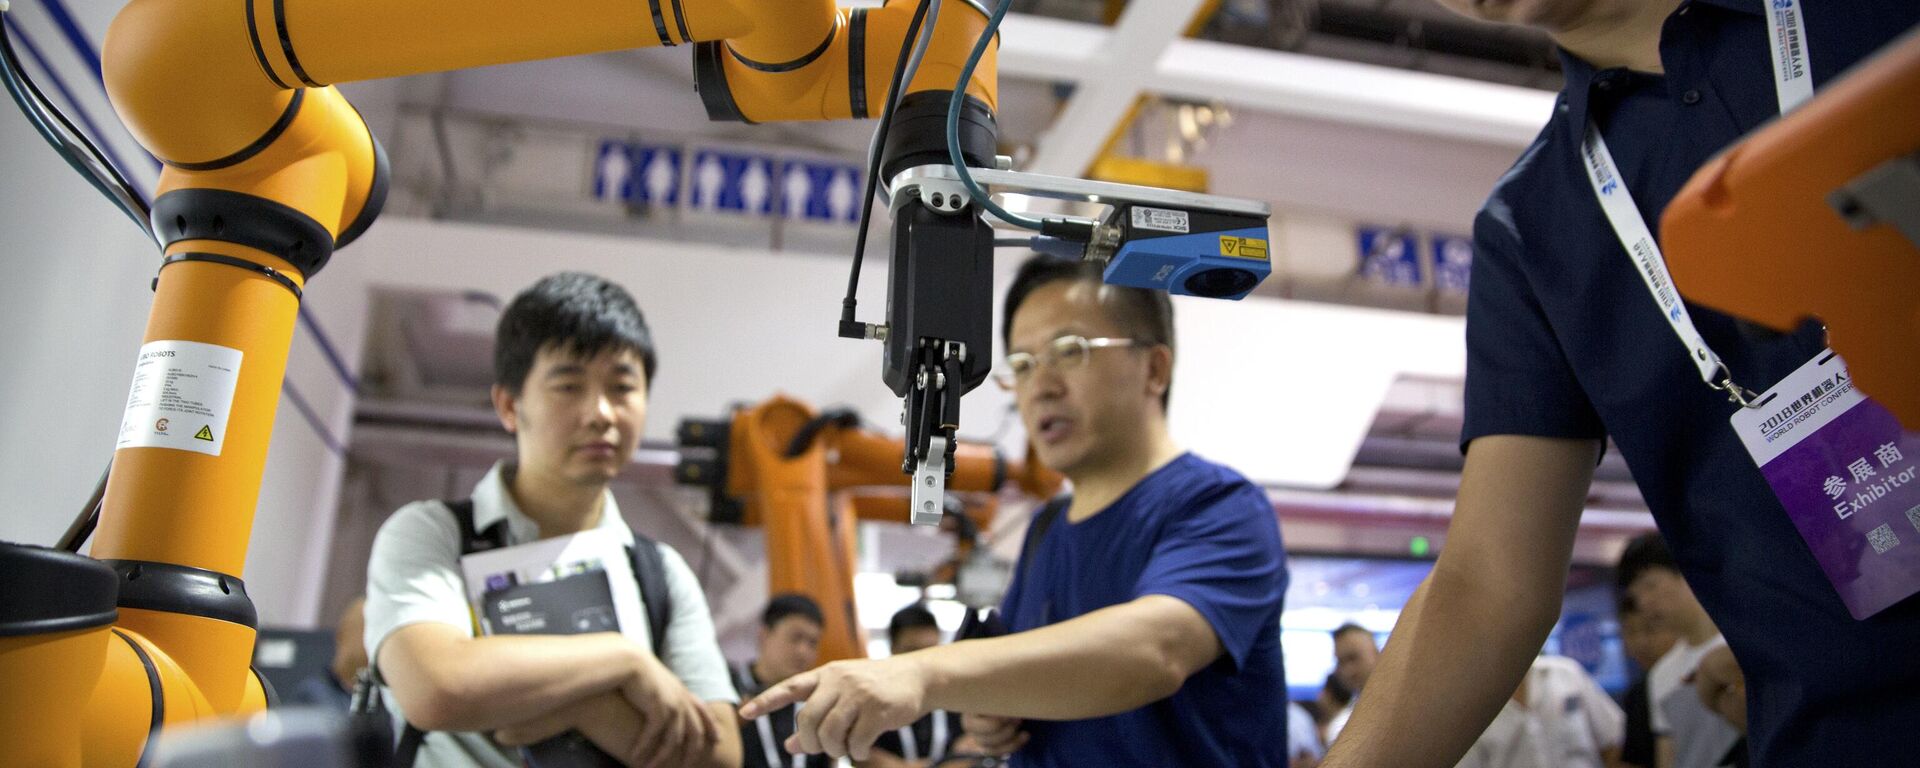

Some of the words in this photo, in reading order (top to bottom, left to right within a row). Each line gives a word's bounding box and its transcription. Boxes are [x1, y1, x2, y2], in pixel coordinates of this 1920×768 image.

[1766, 422, 1794, 443] WORLD
[1794, 403, 1820, 425] ROBOT
[1821, 382, 1857, 407] CONFER
[1823, 441, 1903, 500] 参展商
[1833, 466, 1915, 519] Exhibitor
